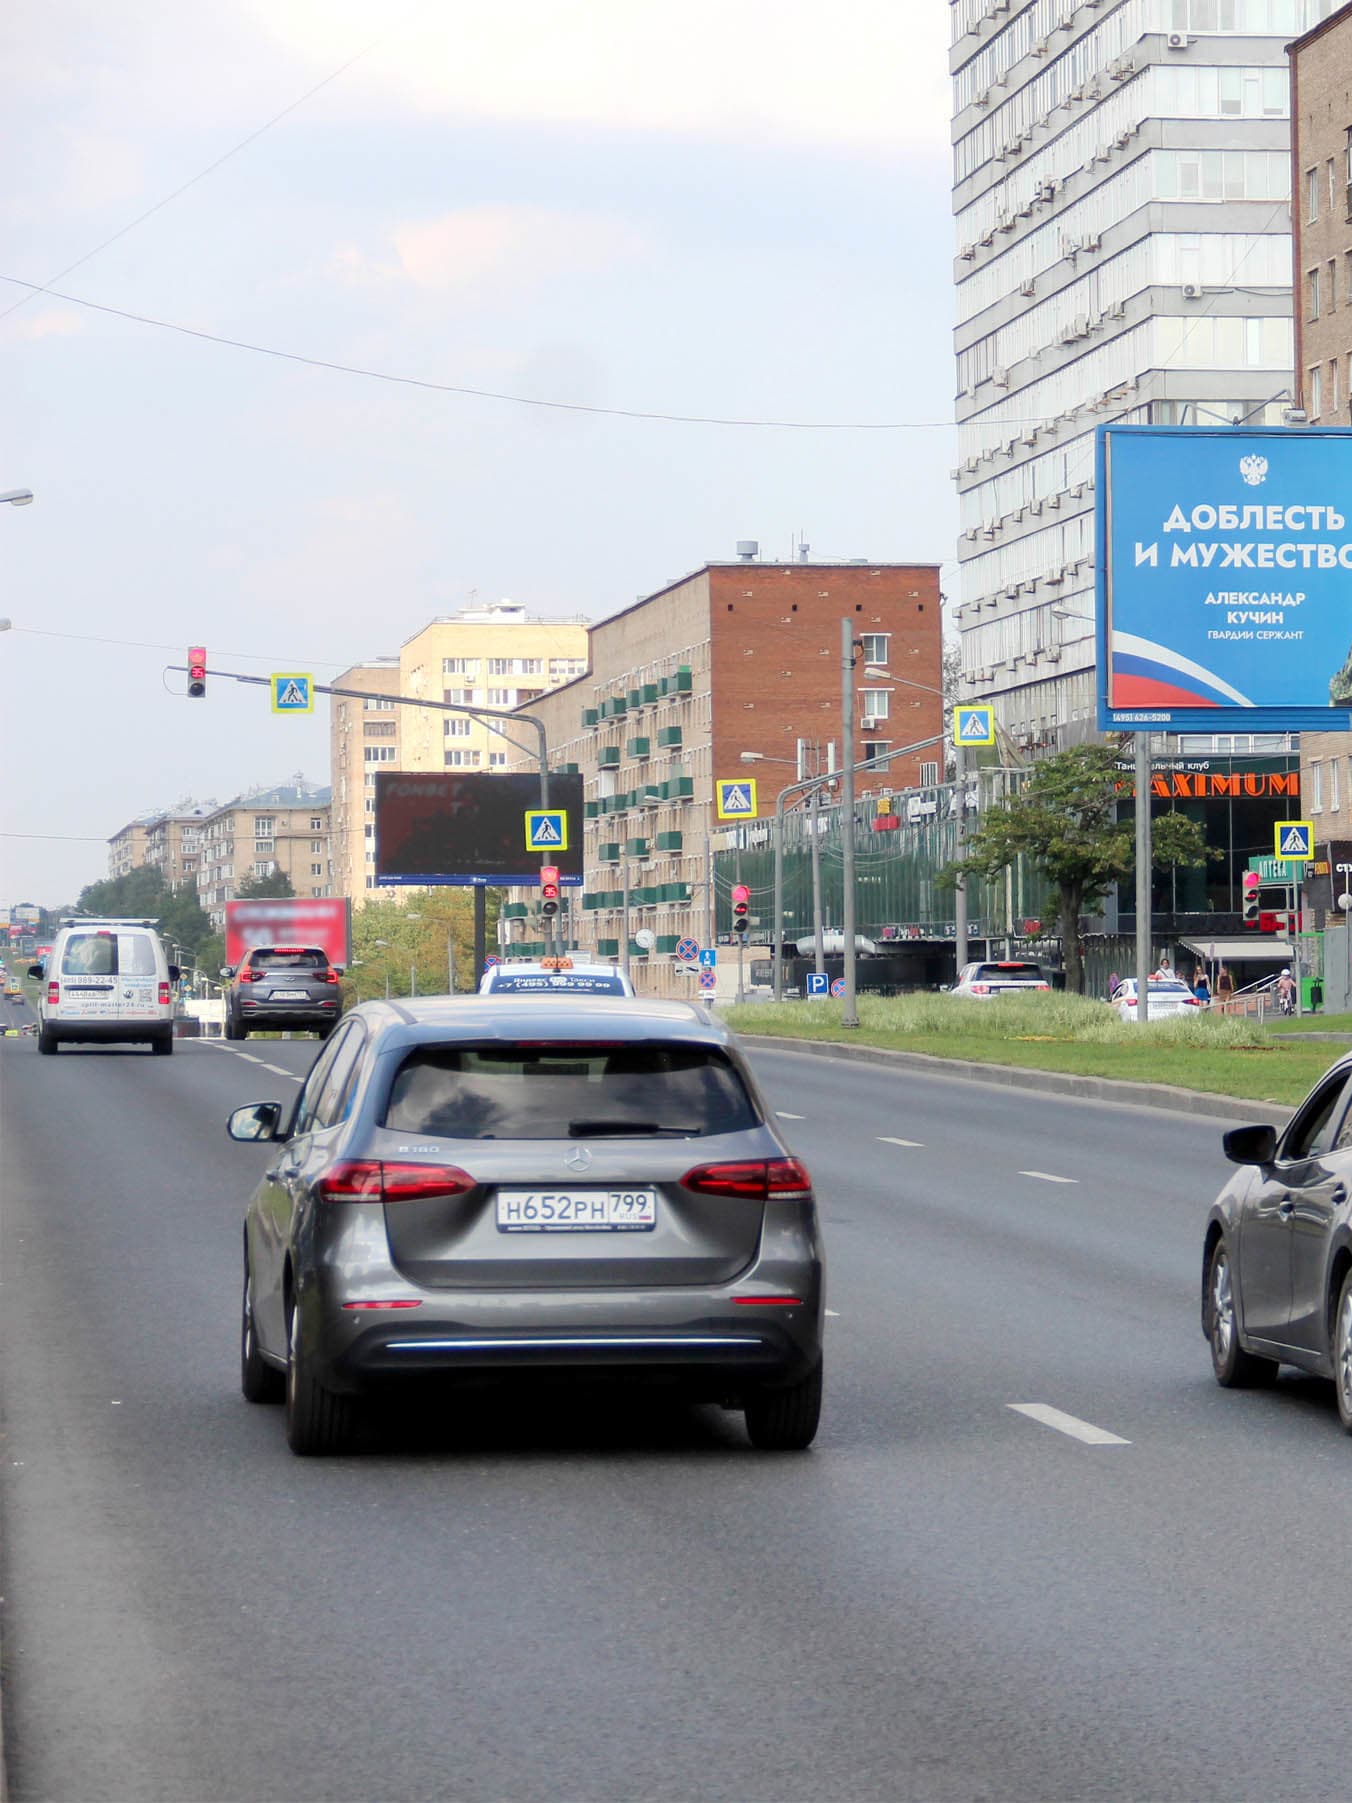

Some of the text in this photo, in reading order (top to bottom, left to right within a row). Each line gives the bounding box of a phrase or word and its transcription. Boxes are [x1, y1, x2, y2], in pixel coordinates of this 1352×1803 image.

[1163, 504, 1345, 532] ДОБЛЕСТЬ
[1135, 542, 1158, 567] И
[1204, 592, 1306, 606] АЛЕКСАНДР
[1227, 611, 1284, 625] КУЧИН
[1208, 630, 1304, 640] ГВАРДИИ СЕРЖАНТ
[1187, 760, 1210, 771] клуб
[1115, 773, 1299, 798] AXIMUM
[1258, 860, 1287, 878] АПТЕКА
[611, 1194, 648, 1213] 799
